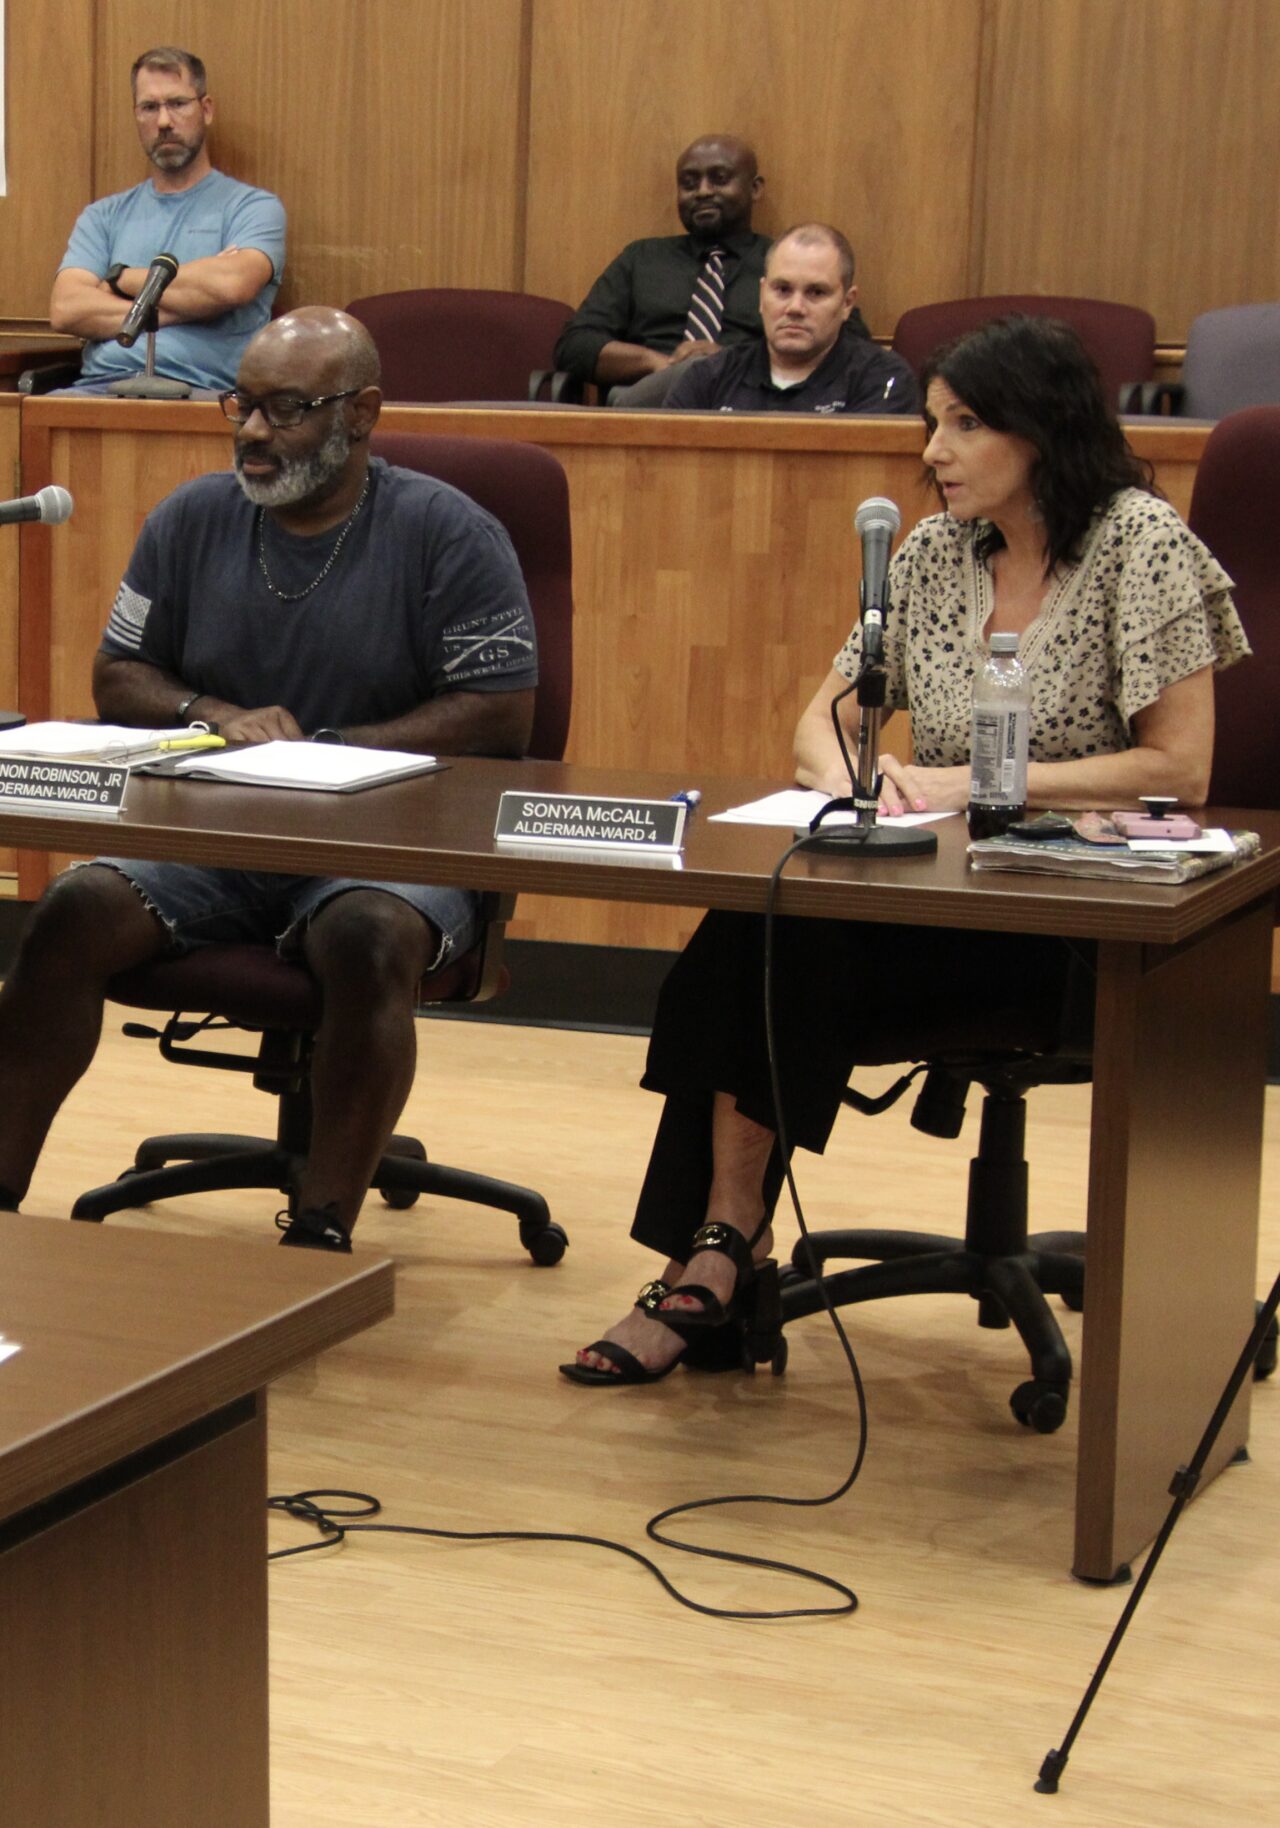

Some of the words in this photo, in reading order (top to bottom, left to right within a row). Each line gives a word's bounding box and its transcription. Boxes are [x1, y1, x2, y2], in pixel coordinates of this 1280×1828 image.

[443, 618, 488, 634] GRUNT
[479, 646, 509, 662] GS
[446, 671, 471, 681] THIS
[30, 766, 100, 787] ROBINSON,
[104, 773, 122, 786] JR
[100, 790, 109, 802] 6
[522, 802, 583, 820] SONYA
[586, 806, 654, 825] McCALL
[514, 820, 646, 841] ALDERMAN-WARD
[648, 830, 657, 842] 4
